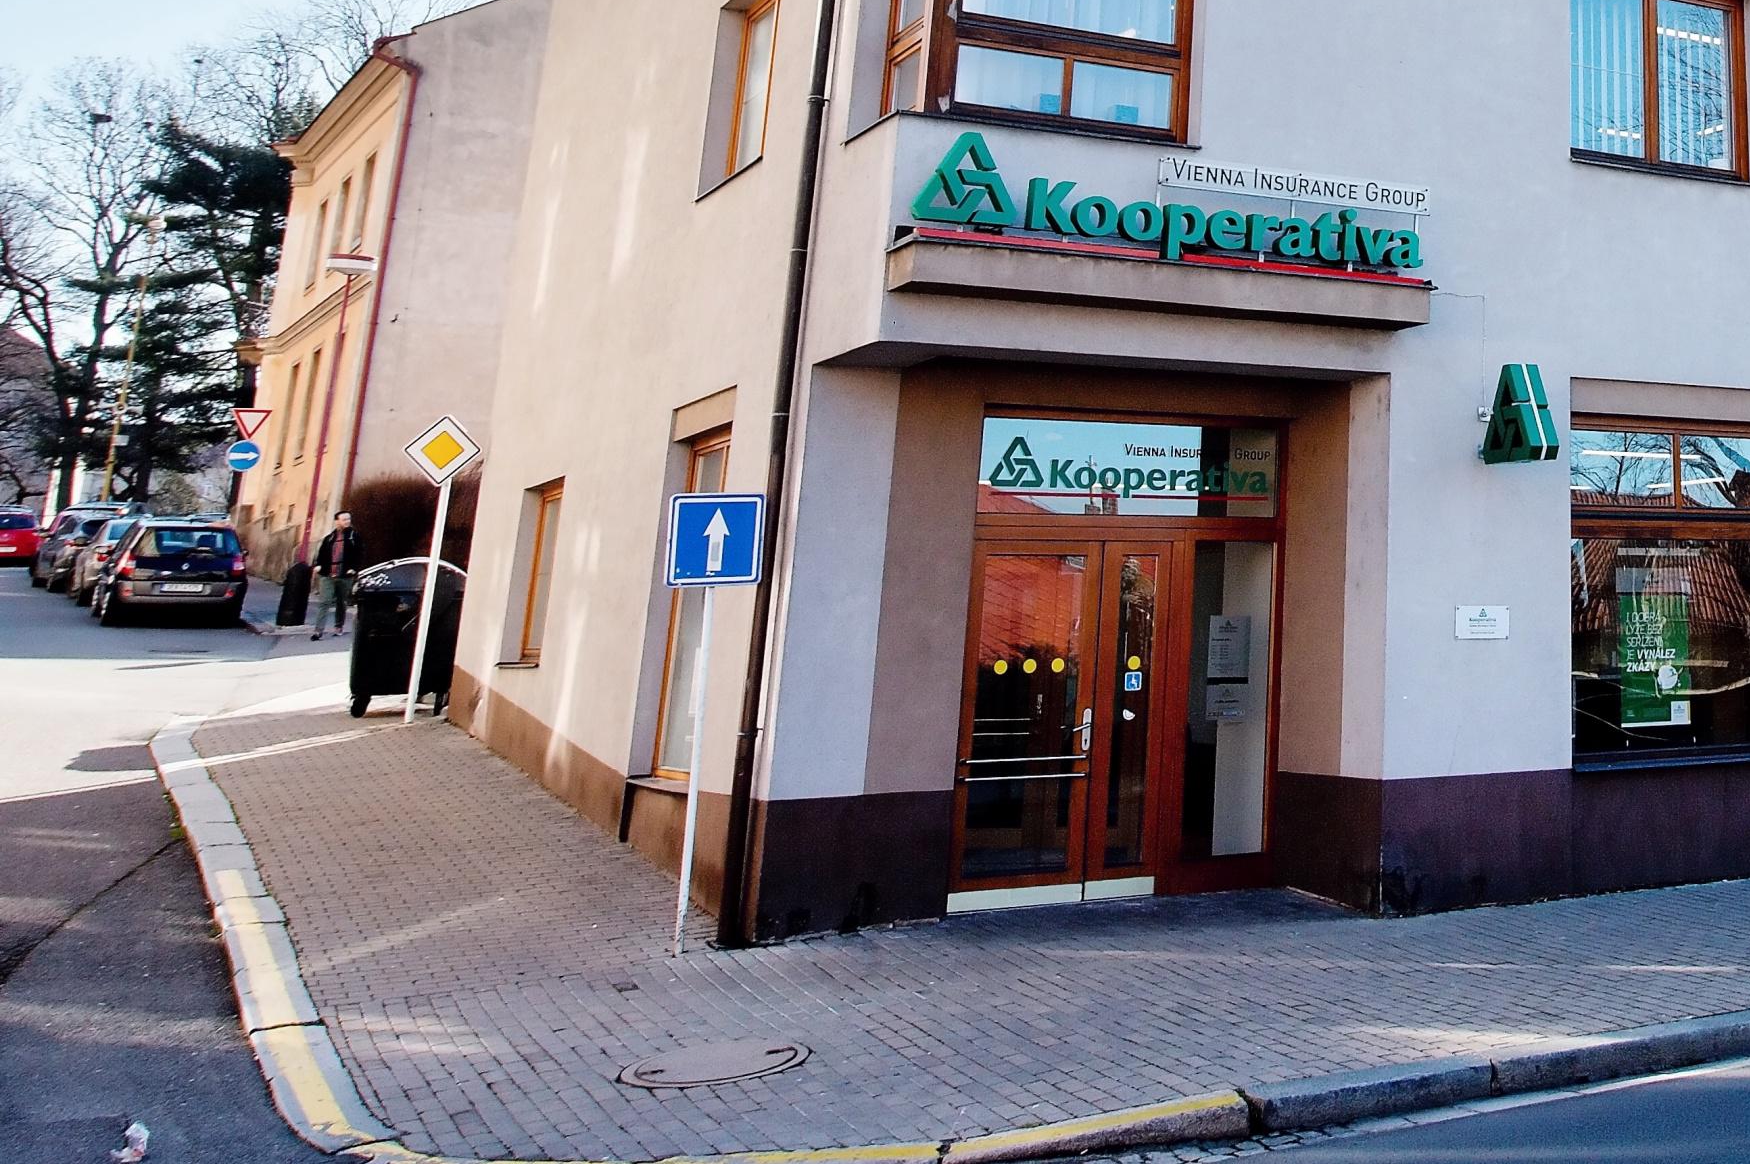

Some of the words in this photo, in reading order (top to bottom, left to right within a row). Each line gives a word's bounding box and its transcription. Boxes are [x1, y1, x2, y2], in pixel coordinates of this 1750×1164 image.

[1172, 158, 1245, 188] VIENNA
[1254, 168, 1358, 200] INSURANCE
[1365, 182, 1427, 207] GROUP
[1025, 177, 1423, 268] Kooperativa
[1125, 443, 1166, 457] VIENNA
[1234, 447, 1271, 461] GROUP
[1050, 458, 1269, 498] Kooperativa
[1637, 646, 1676, 659] VYNÁLEZ
